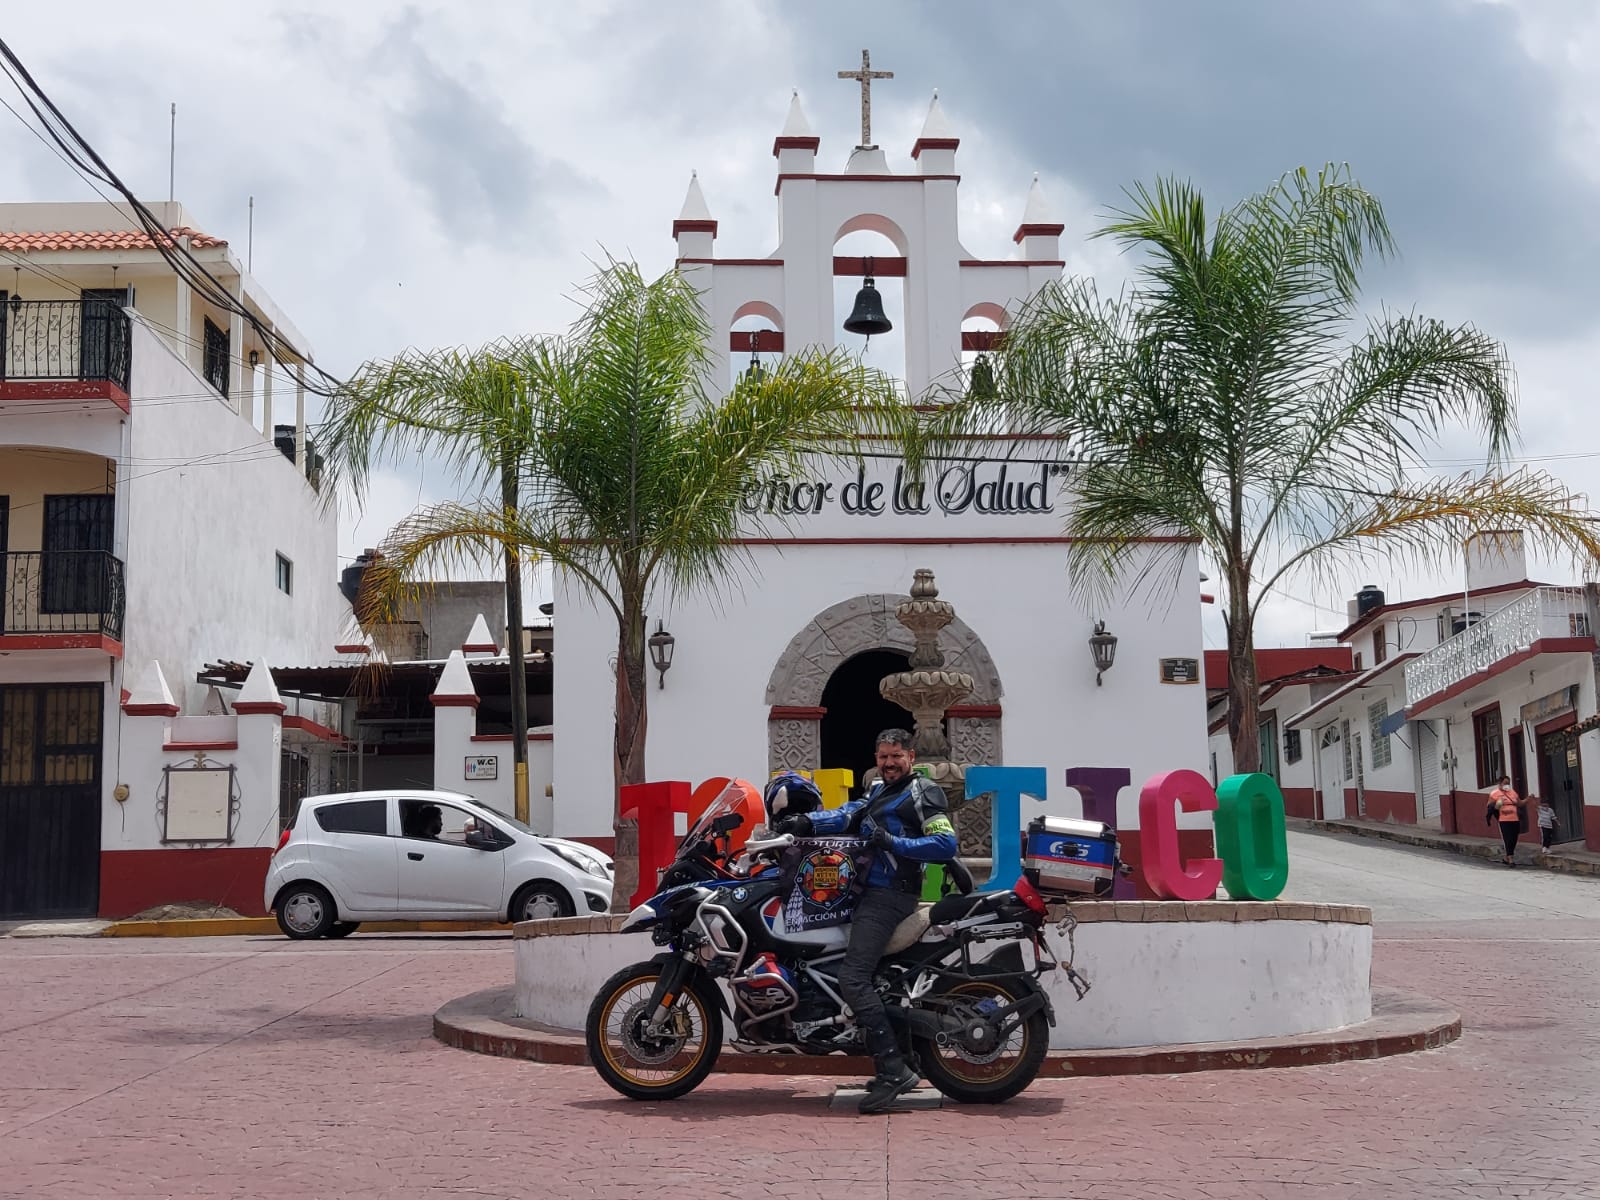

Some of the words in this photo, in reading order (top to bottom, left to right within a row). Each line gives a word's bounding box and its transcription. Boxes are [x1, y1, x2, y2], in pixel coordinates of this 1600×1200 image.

[741, 472, 834, 515] eñor
[840, 463, 884, 516] de
[893, 464, 930, 514] la
